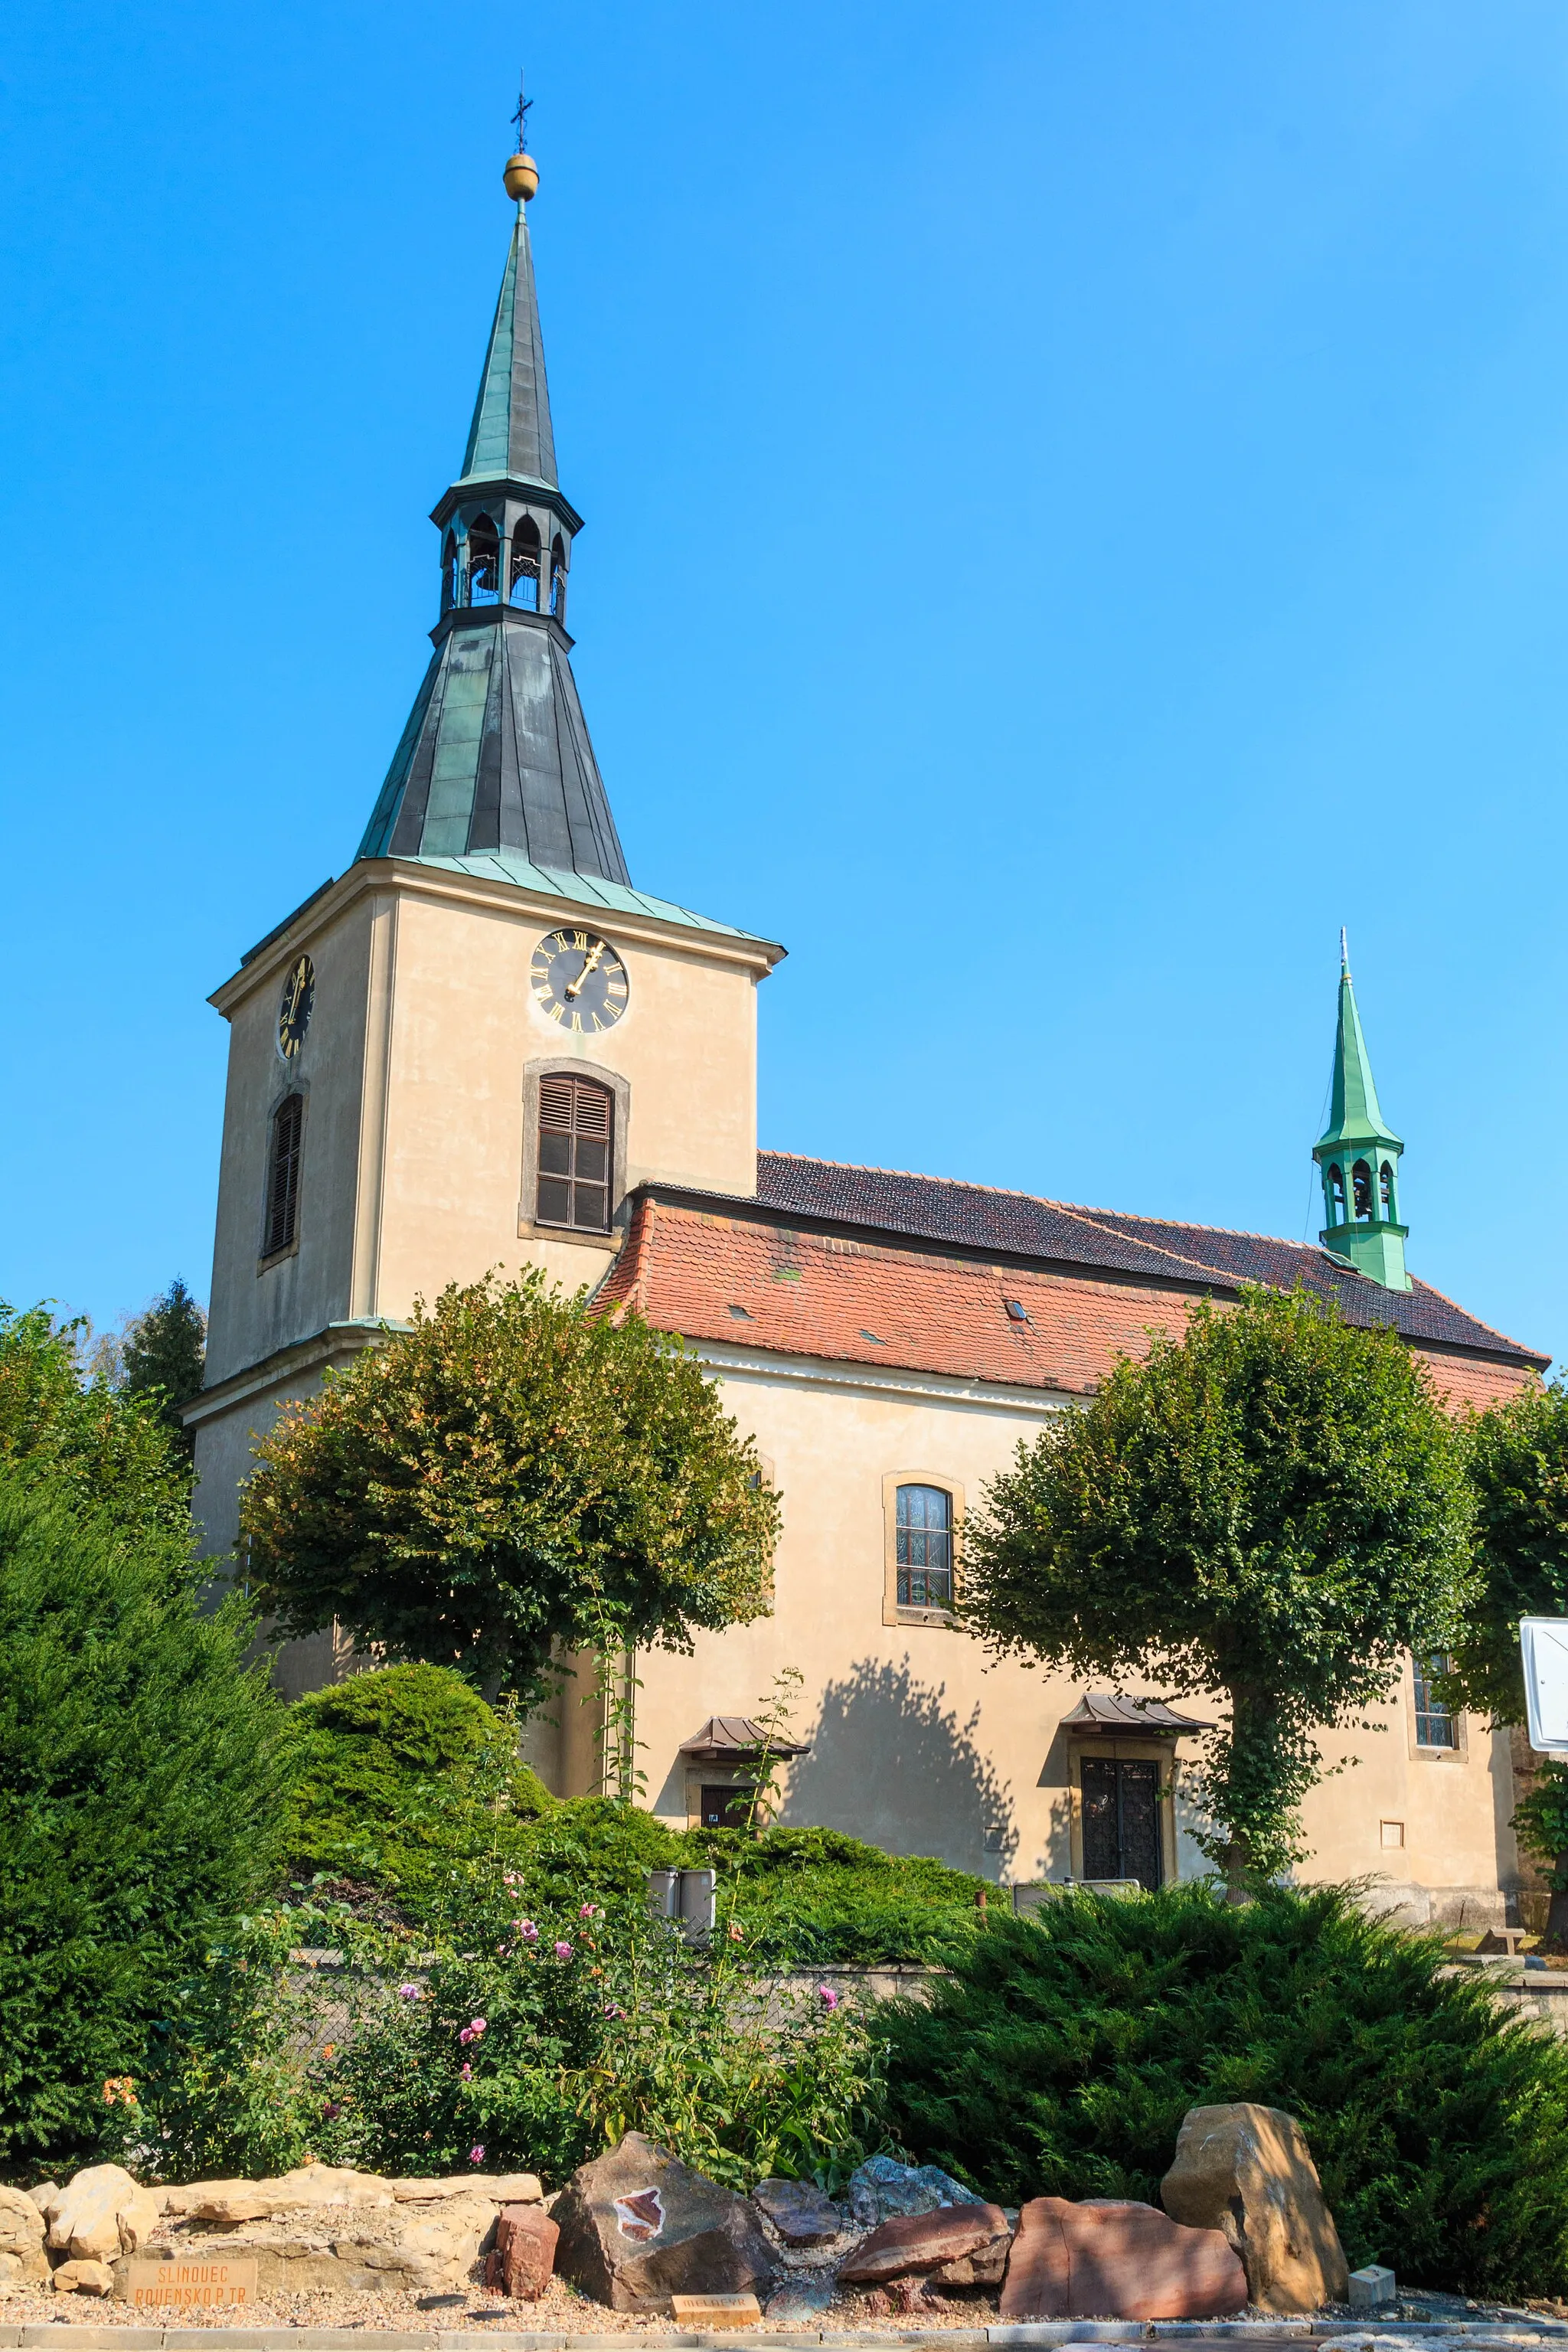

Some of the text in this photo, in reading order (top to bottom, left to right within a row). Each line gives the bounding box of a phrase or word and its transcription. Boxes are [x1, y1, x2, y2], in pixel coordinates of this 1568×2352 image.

[551, 931, 570, 952] XI
[572, 930, 588, 952] XII
[536, 942, 556, 964] X
[530, 964, 549, 981] IX
[603, 962, 623, 976] II
[608, 982, 627, 998] III
[603, 998, 622, 1021] IV
[571, 1011, 584, 1034] VI
[591, 1011, 606, 1031] V
